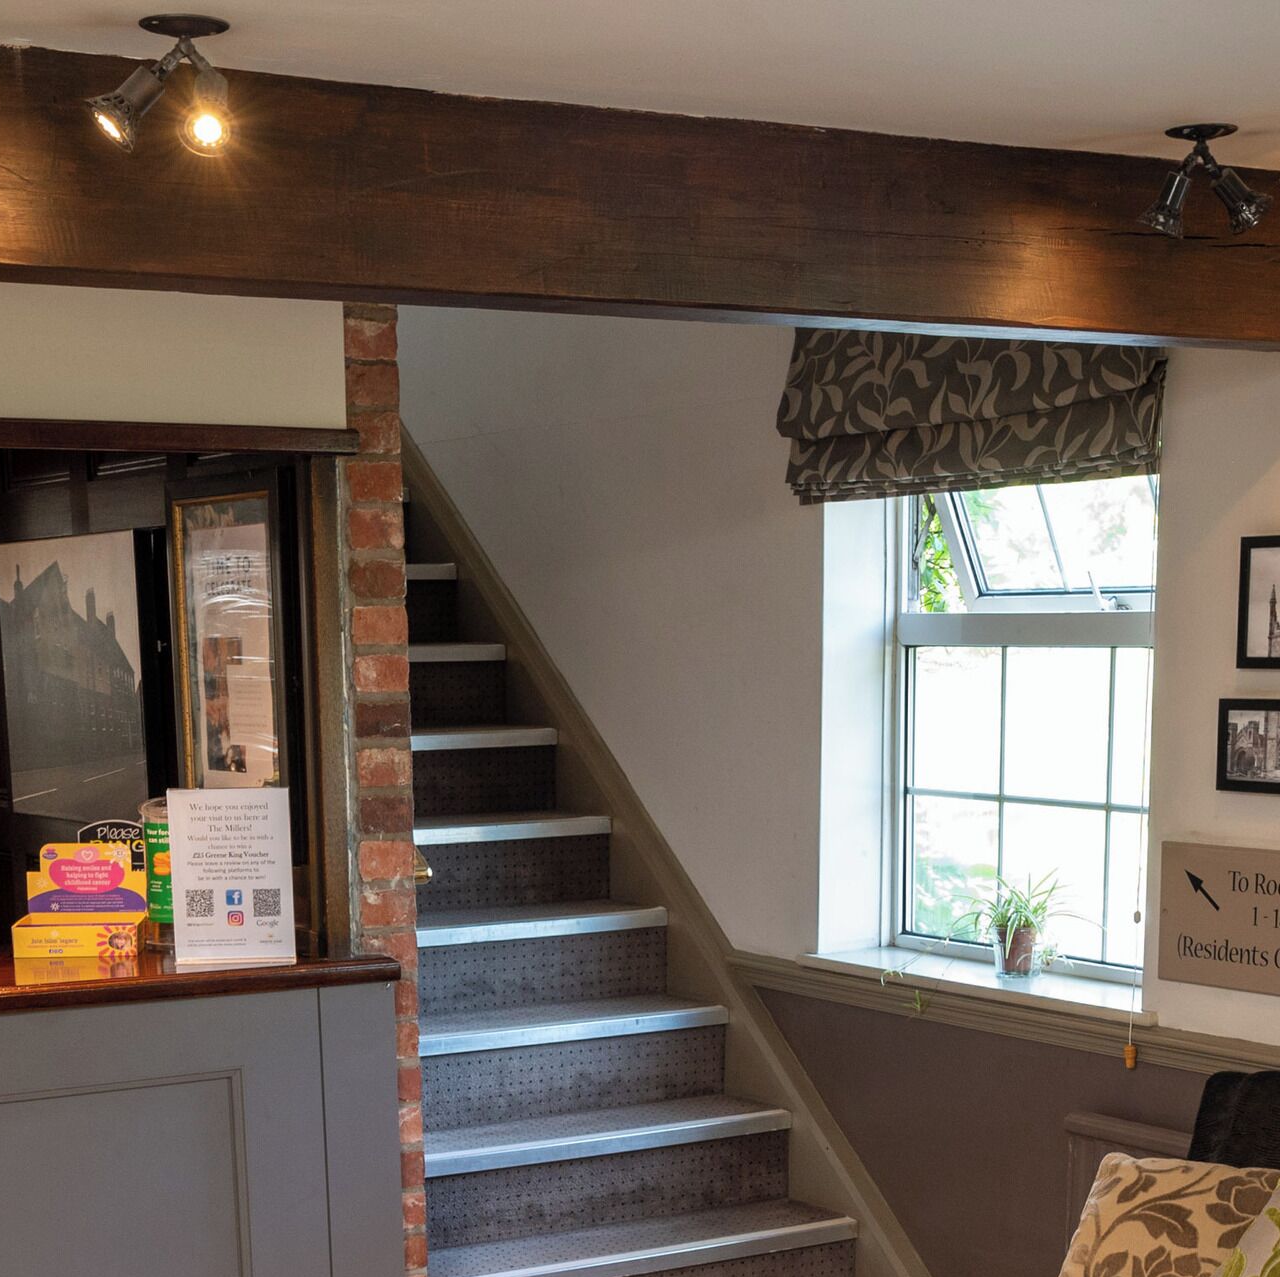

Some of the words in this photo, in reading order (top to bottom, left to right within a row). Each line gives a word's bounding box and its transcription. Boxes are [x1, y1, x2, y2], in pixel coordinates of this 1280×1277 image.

[189, 803, 202, 811] We
[205, 803, 222, 812] hope
[240, 802, 269, 812] enjoyed
[96, 825, 141, 840] Please
[208, 824, 222, 832] The
[225, 824, 252, 832] Millers!
[228, 851, 243, 859] King
[243, 850, 269, 858] Voucher
[94, 871, 109, 879] fight
[1228, 870, 1249, 893] To
[1252, 906, 1259, 927] 1
[256, 919, 280, 928] Google
[1177, 932, 1269, 968] (Residents
